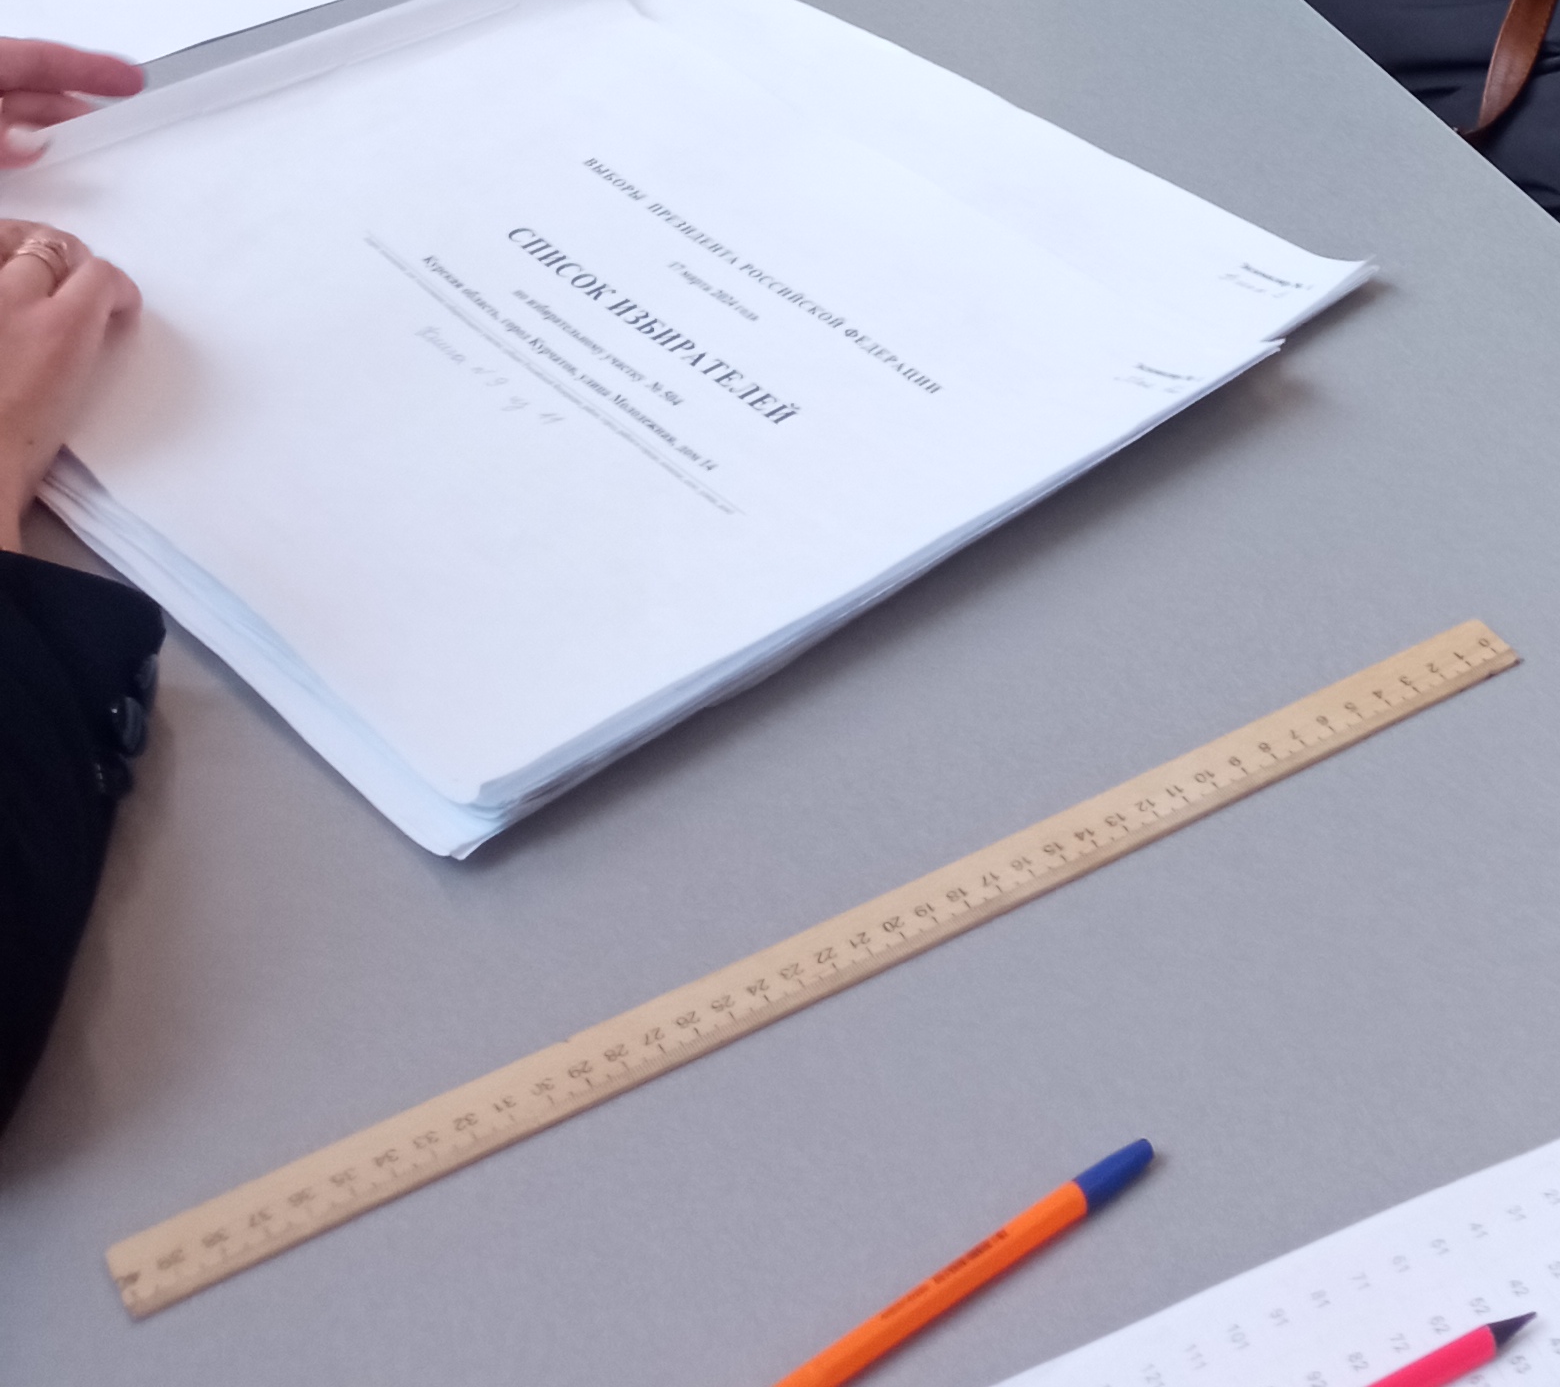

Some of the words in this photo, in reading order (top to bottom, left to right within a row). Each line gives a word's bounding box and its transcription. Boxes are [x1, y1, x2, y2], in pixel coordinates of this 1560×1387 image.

[421, 254, 465, 289] Курская
[582, 157, 647, 201] ВЫБОРЫ
[645, 202, 739, 265] ПРЕЗИДЕНТА
[737, 262, 846, 329] РОССИЙСКОЙ
[843, 327, 943, 394] ФЕДЕРАЦИИ
[507, 226, 617, 301] СПИСОК
[604, 297, 801, 425] ИЗБИРАТЕЛЕЙ
[1478, 638, 1490, 648] 0
[1453, 651, 1464, 661] 1
[1426, 662, 1439, 674] 2
[1400, 675, 1412, 687] 3
[1372, 689, 1384, 700] 4
[1344, 702, 1356, 712] 5
[1316, 716, 1328, 726] 6
[1290, 729, 1298, 740] 7
[1258, 742, 1271, 753] 8
[1228, 756, 1241, 767] 9
[1194, 770, 1215, 784] 10
[1165, 784, 1184, 798] 11
[1134, 798, 1155, 813] 12
[1104, 812, 1126, 827] 13
[1074, 828, 1095, 841] 14
[1043, 842, 1063, 855] 15
[1011, 856, 1032, 871] 16
[981, 871, 1000, 887] 17
[946, 887, 968, 902] 18
[914, 903, 935, 917] 19
[882, 916, 905, 933] 20
[849, 932, 871, 949] 21
[815, 947, 837, 964] 22
[779, 963, 804, 980] 23
[746, 979, 770, 995] 24
[710, 995, 735, 1012] 25
[675, 1011, 701, 1028] 26
[643, 1027, 665, 1046] 27
[603, 1044, 629, 1062] 28
[567, 1060, 593, 1078] 29
[492, 1095, 517, 1113] 31
[453, 1113, 478, 1131] 32
[412, 1131, 439, 1149] 33
[373, 1148, 399, 1167] 34
[1506, 1204, 1527, 1221] 31
[1469, 1222, 1490, 1238] 41
[1429, 1238, 1451, 1256] 51
[1391, 1254, 1411, 1273] 61
[1350, 1271, 1371, 1290] 71
[1509, 1278, 1530, 1297] 42
[1468, 1296, 1491, 1316] 52
[1268, 1307, 1290, 1328] 91
[1429, 1315, 1452, 1335] 62
[1390, 1332, 1411, 1353] 72
[1346, 1351, 1370, 1372] 82
[1509, 1354, 1532, 1375] 53
